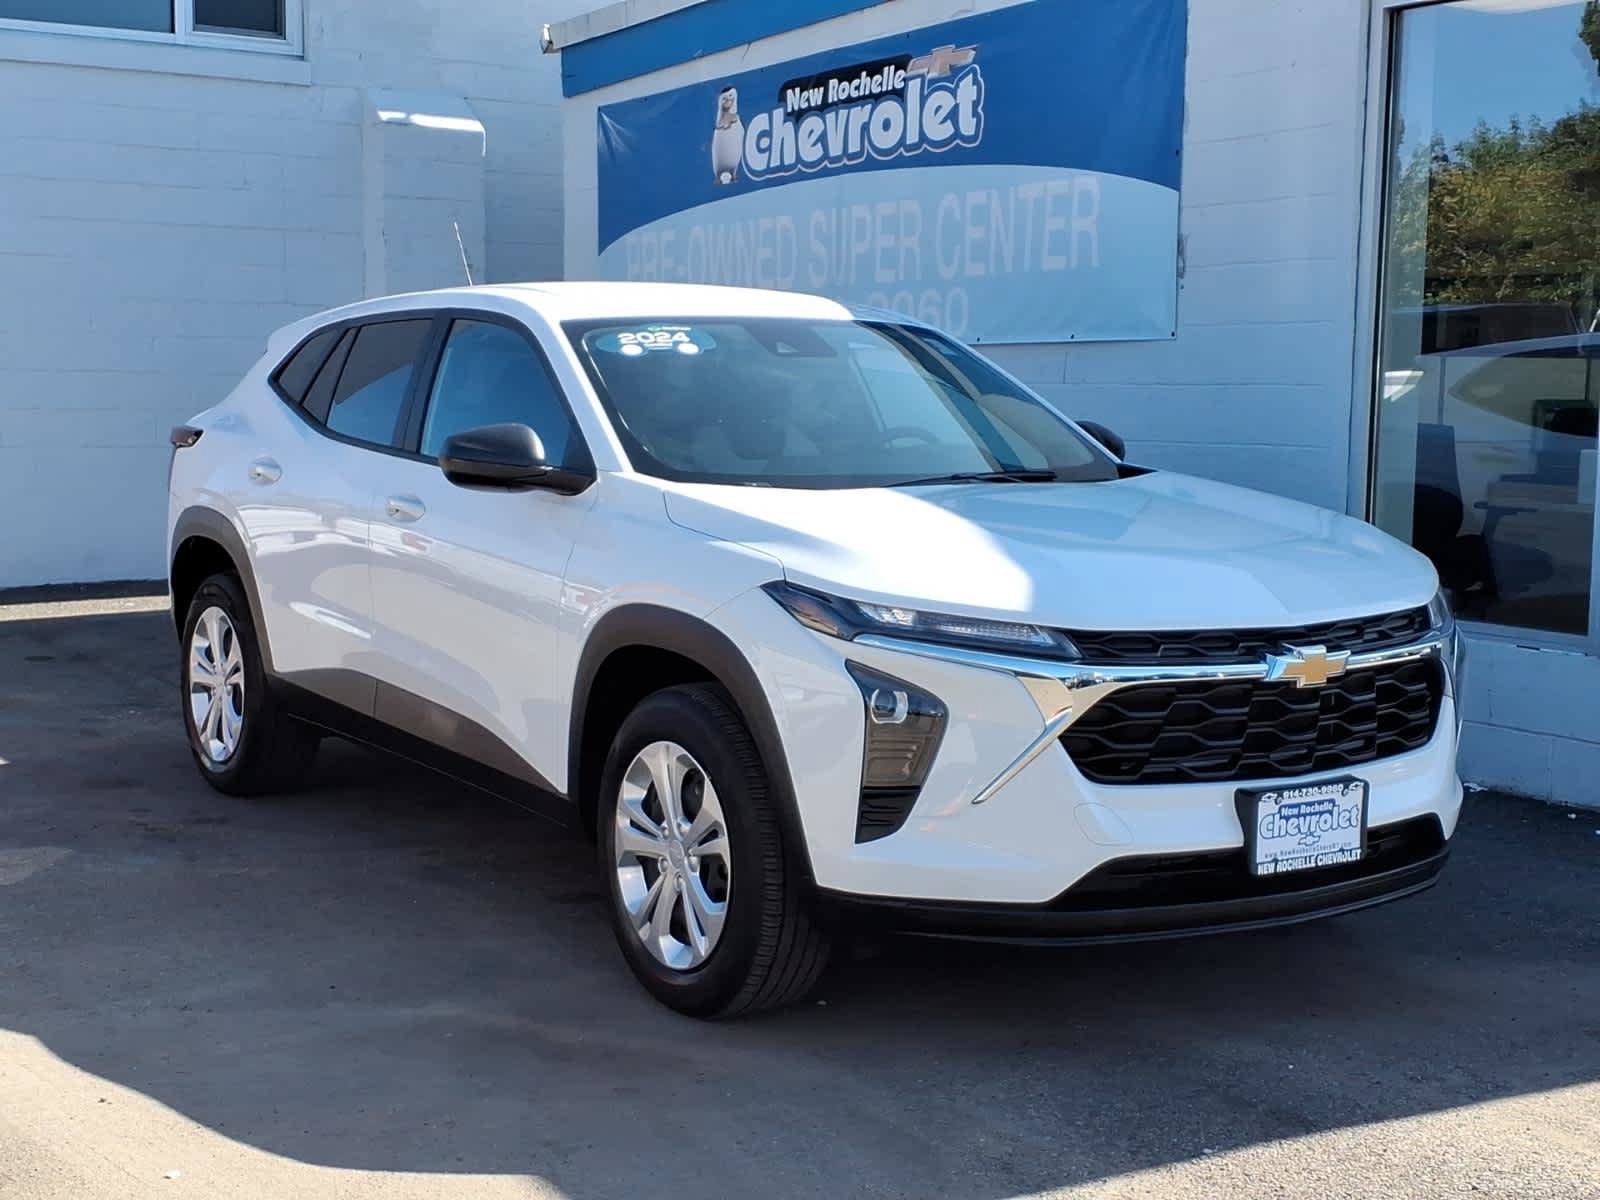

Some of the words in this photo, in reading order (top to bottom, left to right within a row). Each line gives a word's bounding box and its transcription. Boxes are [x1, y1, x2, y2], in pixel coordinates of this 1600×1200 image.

[786, 86, 824, 113] New
[827, 64, 906, 104] Rochelle
[744, 72, 978, 172] Chevrolet
[624, 214, 797, 290] PRE-OWNED
[807, 199, 922, 287] SUPER
[936, 175, 1102, 279] CENTER
[617, 331, 691, 344] 2024
[1259, 804, 1360, 840] Chevrolet
[1281, 806, 1298, 816] New
[1300, 801, 1334, 813] Rochelle
[1257, 862, 1275, 876] NEW
[1276, 854, 1316, 872] ROCHELLE
[1317, 848, 1361, 866] CHEVROLET
